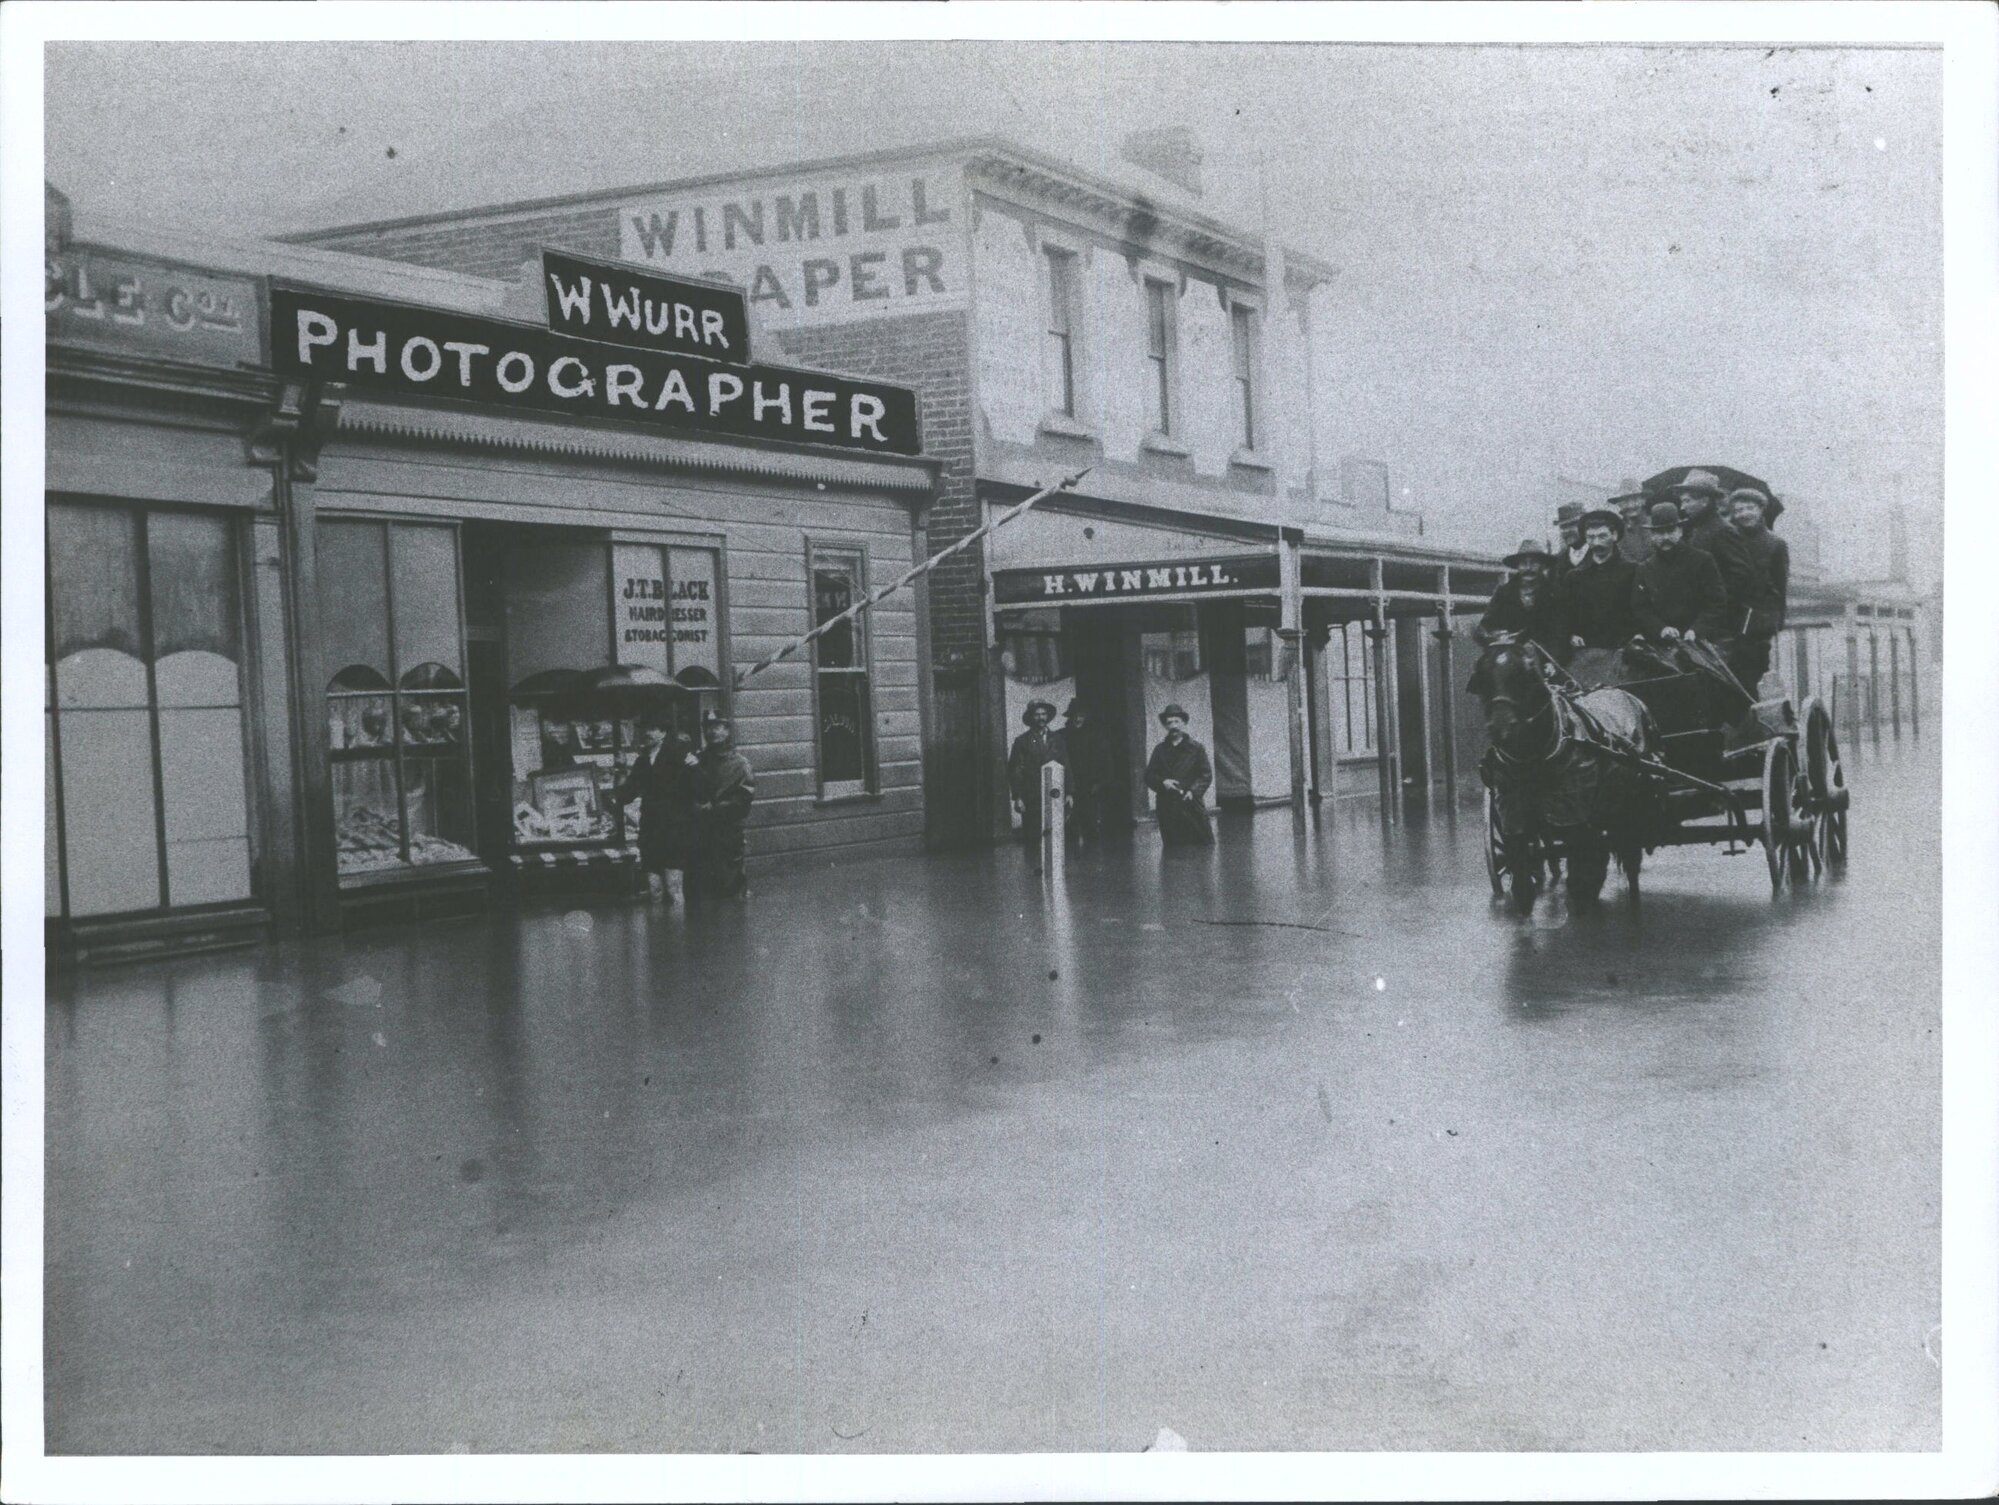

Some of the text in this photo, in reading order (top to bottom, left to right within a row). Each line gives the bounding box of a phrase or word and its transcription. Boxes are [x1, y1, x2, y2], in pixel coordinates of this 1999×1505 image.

[631, 177, 951, 259] WINMILL
[549, 273, 730, 349] W WURR
[700, 246, 947, 309] APER
[296, 308, 889, 443] PHOTOGRAPHER
[629, 606, 707, 622] HAIRDESSER
